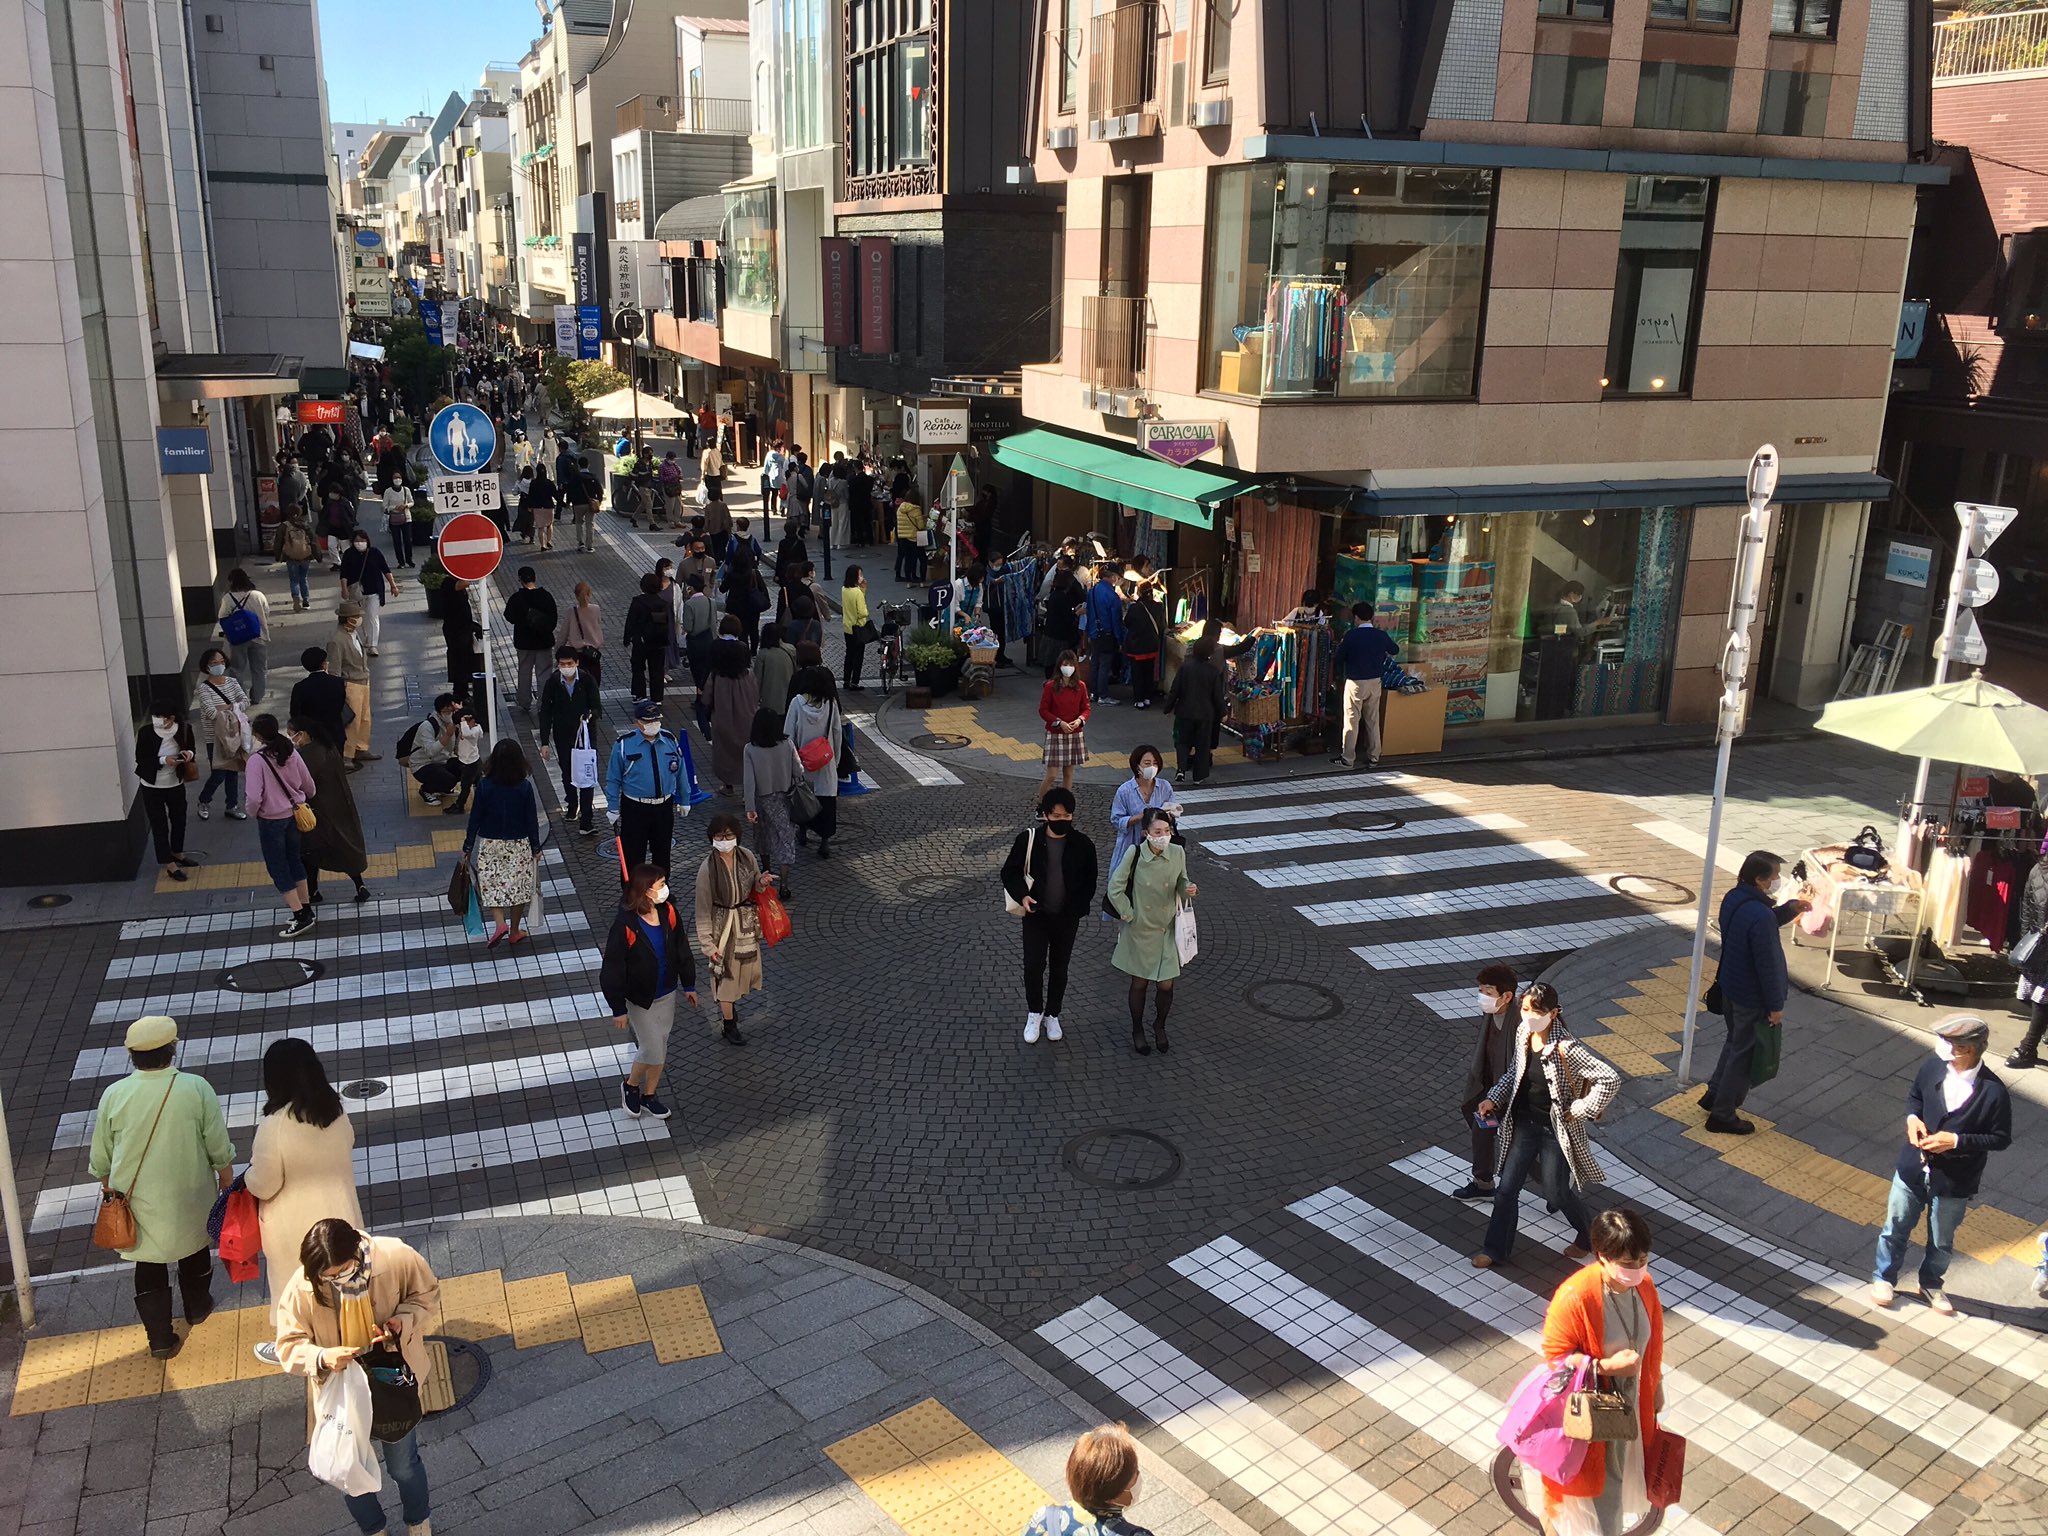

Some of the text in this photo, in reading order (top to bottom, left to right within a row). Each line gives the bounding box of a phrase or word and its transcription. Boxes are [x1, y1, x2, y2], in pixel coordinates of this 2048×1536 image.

[344, 246, 352, 272] GINZA
[448, 248, 457, 278] picard
[579, 257, 589, 302] KAGURA
[618, 246, 631, 299] 炭火焙煎珈琲
[831, 264, 843, 334] TRECENTI
[871, 265, 883, 341] TRECENTI
[923, 420, 962, 431] Renoir
[164, 446, 206, 457] familiar
[1166, 448, 1199, 456] カラカラ
[1898, 569, 1925, 580] KUMON
[936, 589, 948, 607] P
